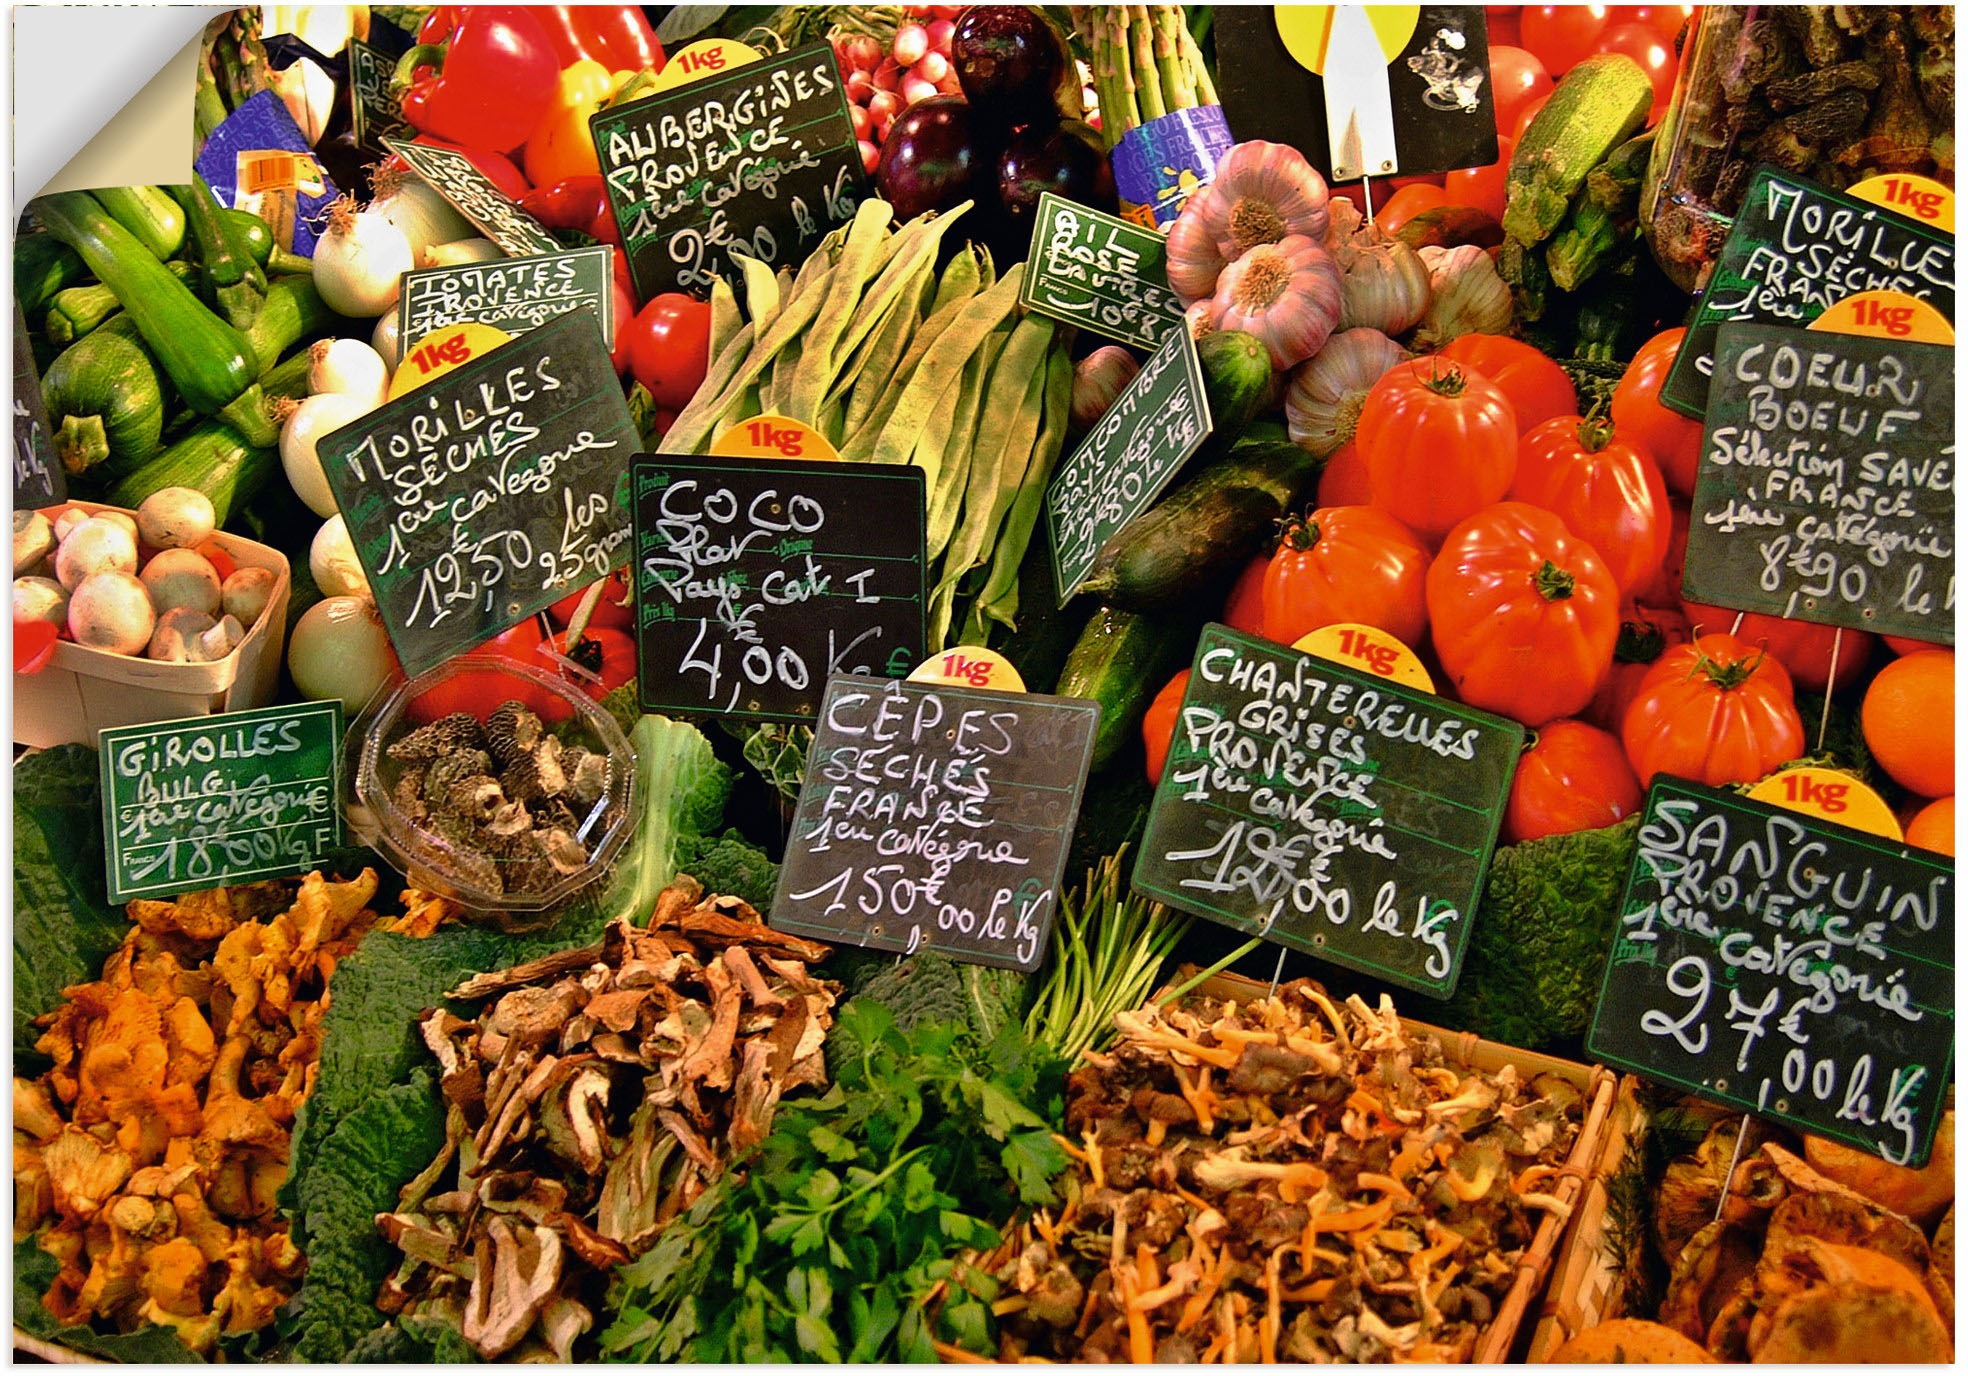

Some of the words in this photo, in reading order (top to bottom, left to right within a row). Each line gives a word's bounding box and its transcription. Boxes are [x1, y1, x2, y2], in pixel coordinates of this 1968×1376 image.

[677, 46, 726, 74] 1kg
[1884, 179, 1945, 220] 1kg
[410, 259, 577, 302] TOMATES
[1852, 299, 1915, 337] 1kg
[410, 332, 472, 376] 1kg
[1735, 344, 1920, 406] COEUR
[1747, 384, 1922, 443] BOEUF
[747, 421, 805, 457] 1kg
[660, 480, 825, 533] COCO
[1764, 470, 1916, 518] FRANCE
[942, 653, 994, 687] 1kg
[1337, 629, 1401, 677] 1kg
[1183, 706, 1378, 809] PROVENCE
[821, 784, 995, 829] FRANCE
[1782, 774, 1852, 814] 1kg
[1637, 799, 1948, 932] SANGUIN
[1638, 847, 1888, 961] PROVENCE
